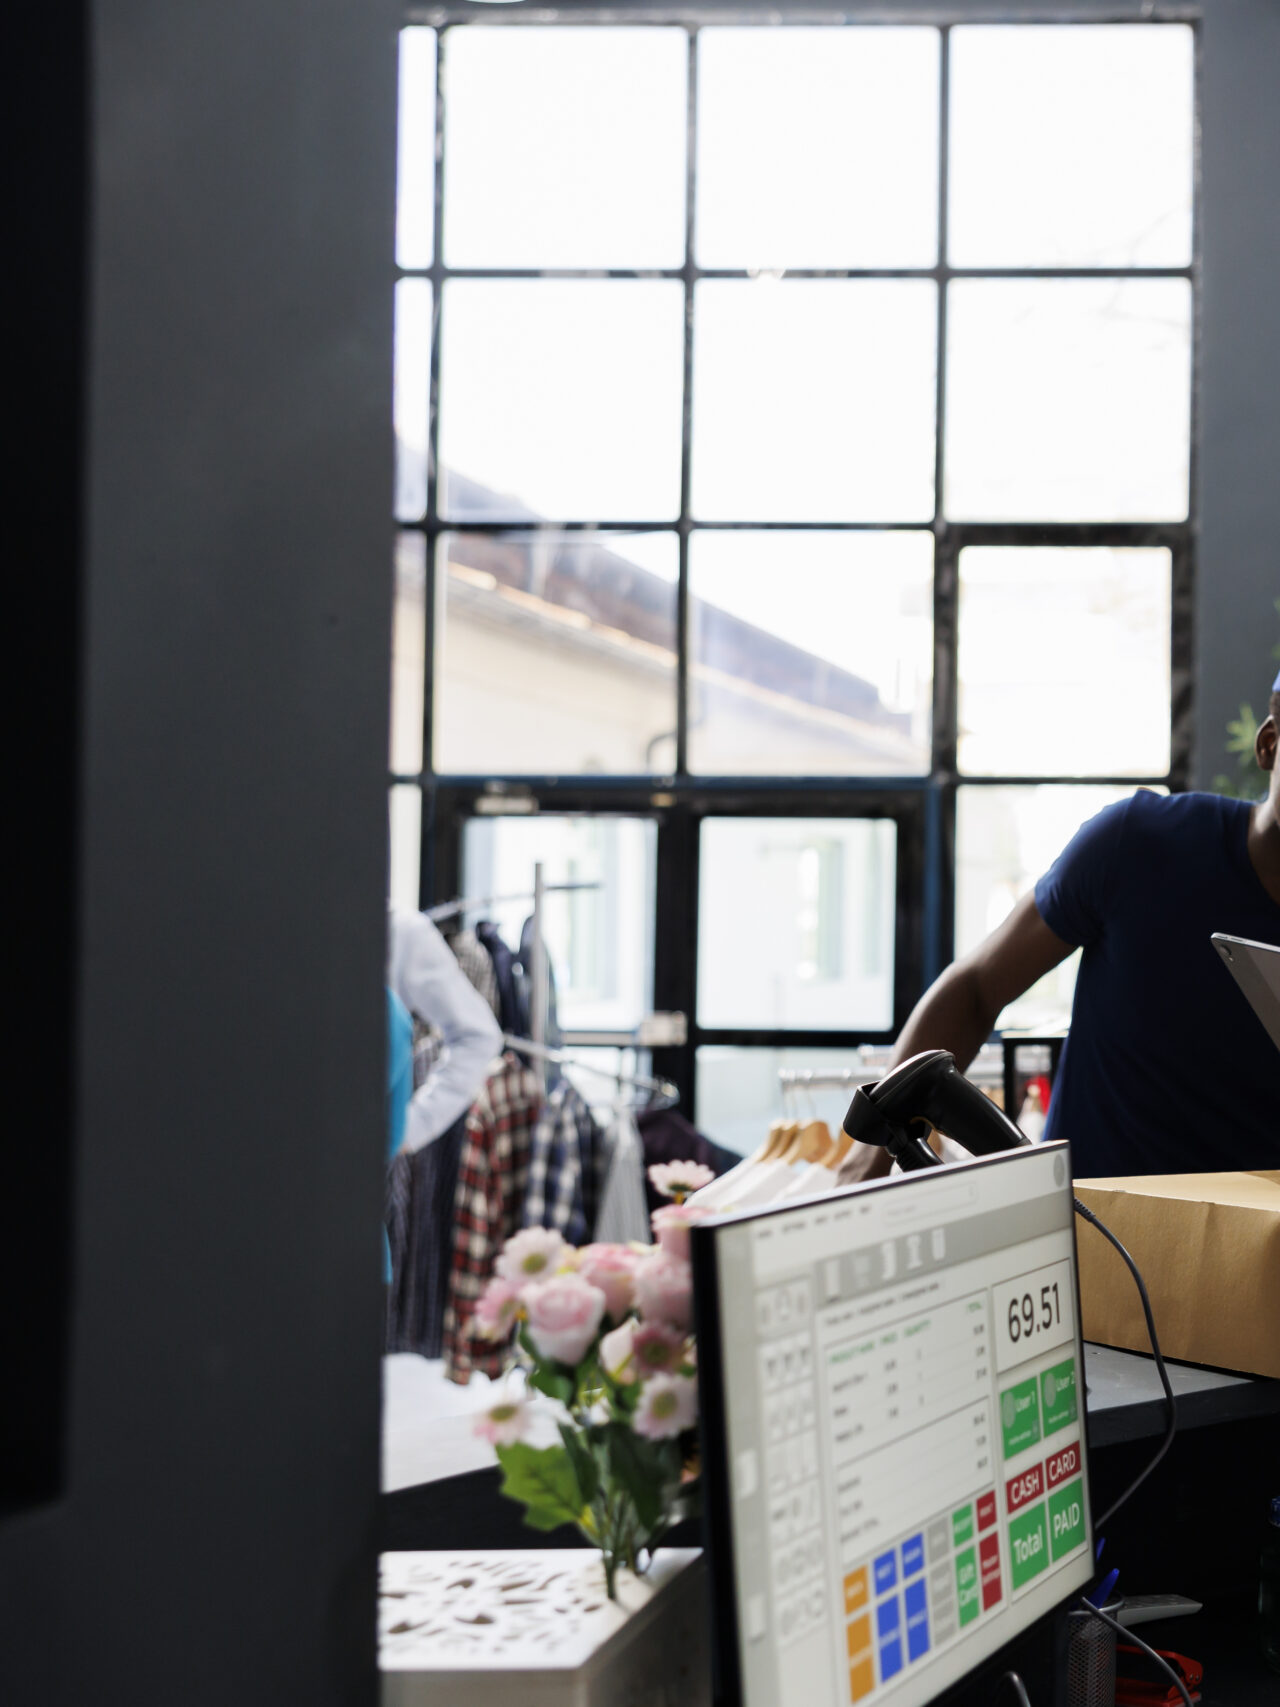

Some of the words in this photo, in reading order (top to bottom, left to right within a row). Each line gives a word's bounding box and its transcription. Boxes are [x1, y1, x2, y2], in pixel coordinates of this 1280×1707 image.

[1008, 1281, 1060, 1344] 69.51
[1048, 1449, 1076, 1482] CARD
[1011, 1469, 1040, 1504] CASH
[1053, 1502, 1080, 1539] PAID
[1013, 1524, 1043, 1565] Total
